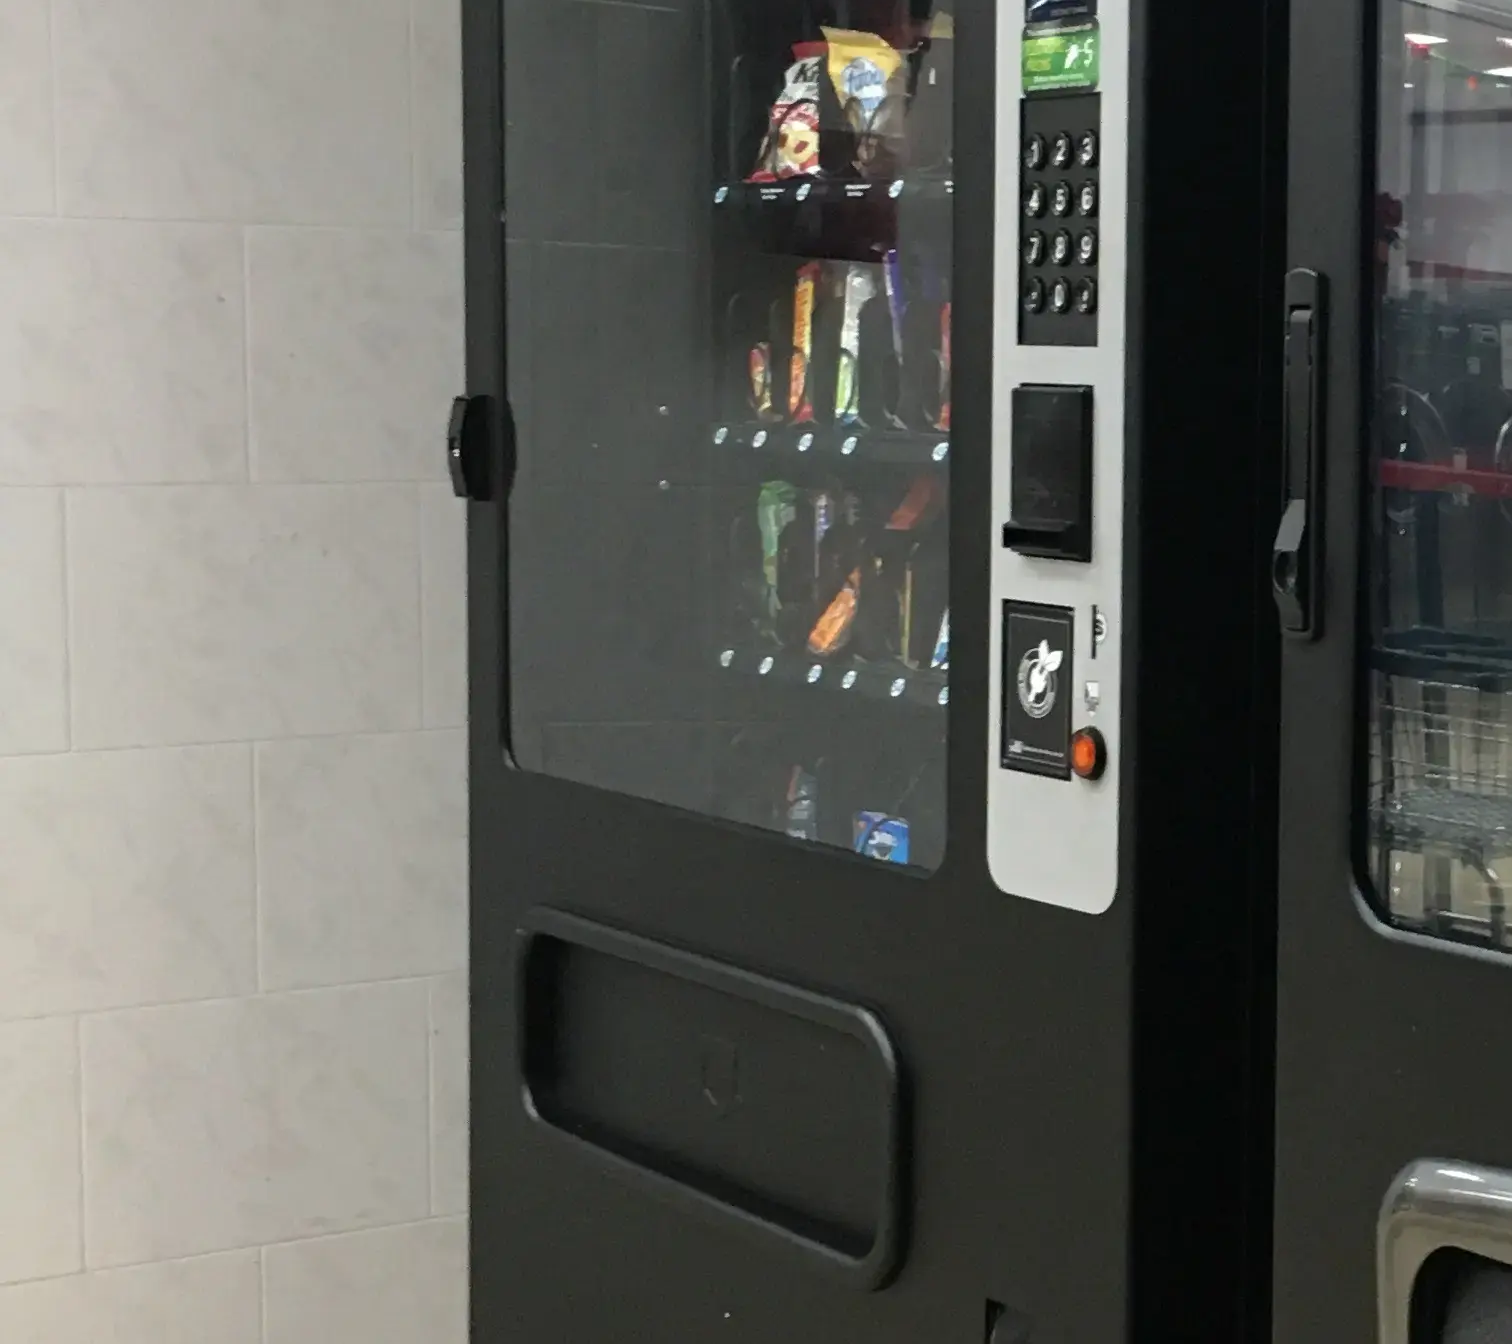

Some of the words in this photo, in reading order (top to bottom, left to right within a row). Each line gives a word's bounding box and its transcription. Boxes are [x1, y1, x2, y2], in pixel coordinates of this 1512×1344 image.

[1055, 138, 1066, 161] 2
[1081, 136, 1092, 161] 3
[1029, 236, 1039, 258] 7
[1081, 235, 1093, 259] 9
[1054, 283, 1065, 307] 0
